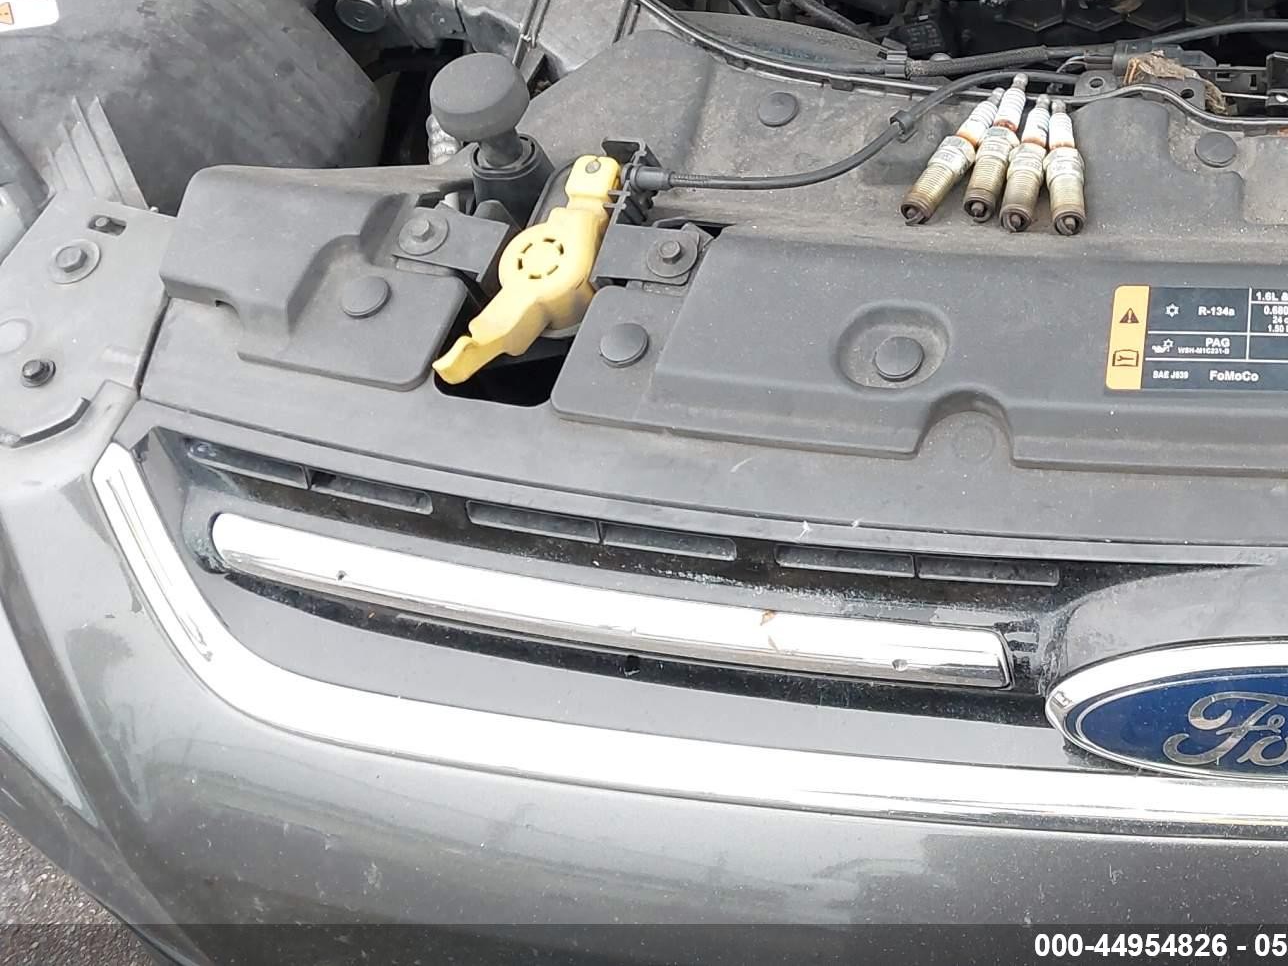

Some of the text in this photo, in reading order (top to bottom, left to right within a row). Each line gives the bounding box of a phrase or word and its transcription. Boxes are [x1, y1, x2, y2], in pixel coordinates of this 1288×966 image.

[1256, 291, 1279, 301] 1.6L
[1281, 292, 1288, 301] &
[1198, 306, 1235, 317] R-134a
[1272, 316, 1282, 324] 24
[1205, 337, 1231, 347] PAG
[1152, 371, 1170, 379] SAE
[1209, 370, 1259, 382] FoMoCo
